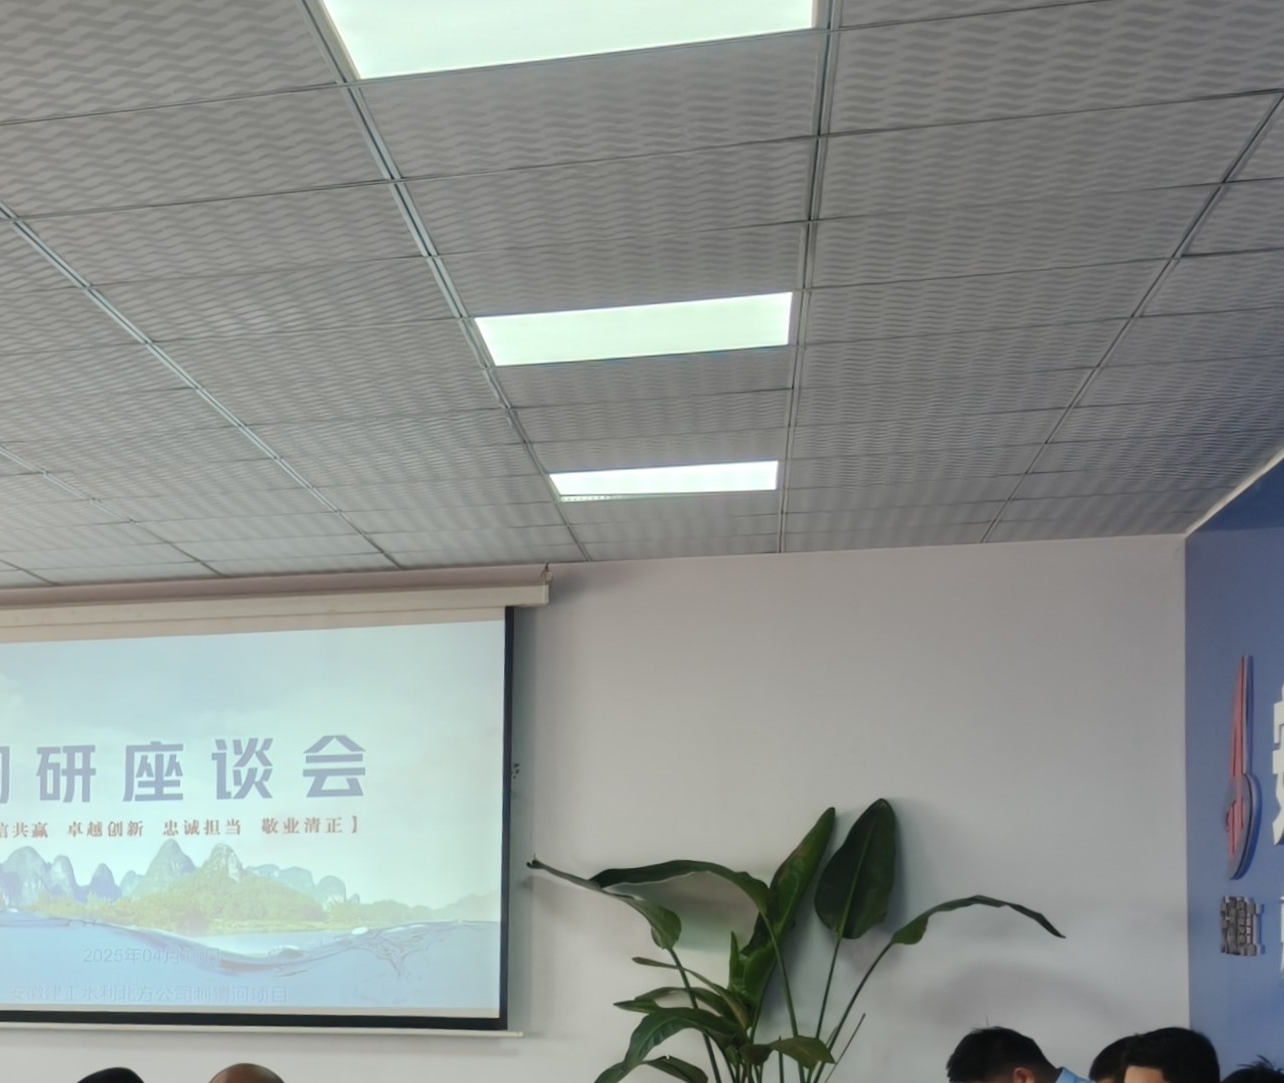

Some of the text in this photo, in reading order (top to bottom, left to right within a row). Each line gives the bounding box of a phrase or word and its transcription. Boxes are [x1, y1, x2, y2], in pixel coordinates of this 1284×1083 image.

[68, 820, 144, 838] 卓越创新
[163, 818, 242, 837] 忠诚担当
